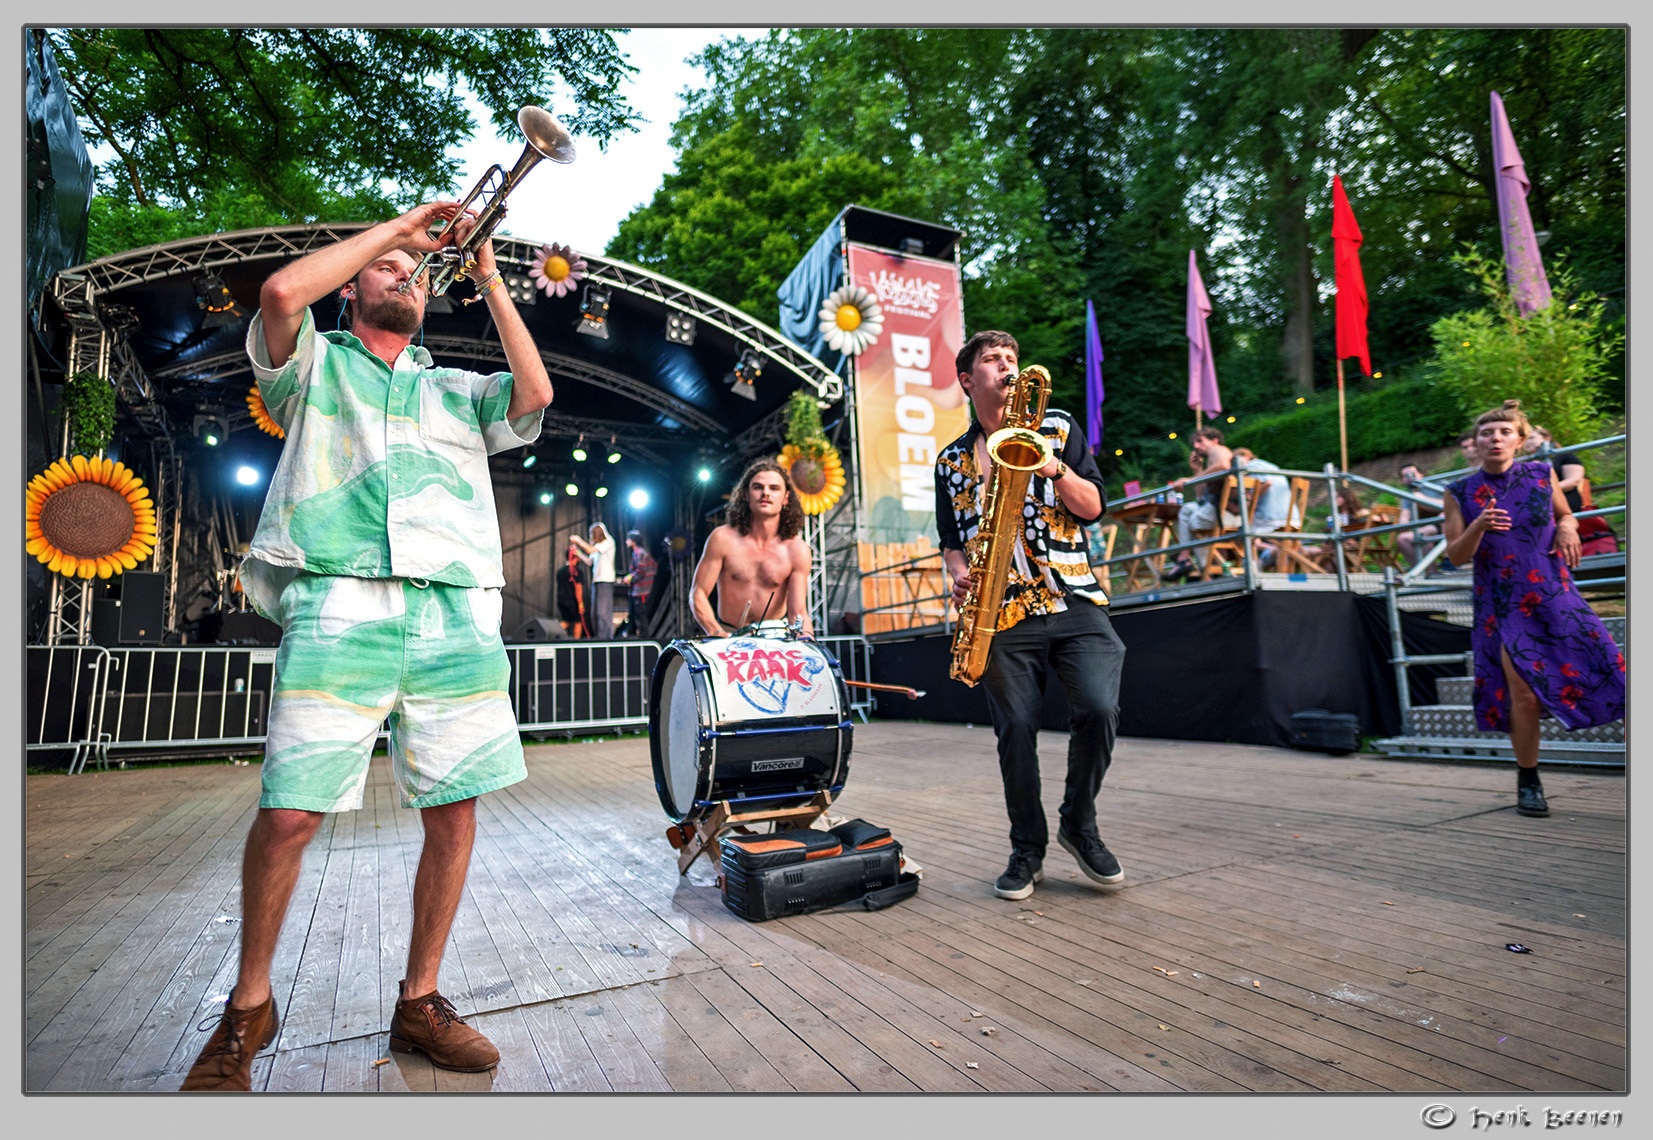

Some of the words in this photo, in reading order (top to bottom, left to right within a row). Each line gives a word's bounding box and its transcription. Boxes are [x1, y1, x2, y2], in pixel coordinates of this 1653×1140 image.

[890, 332, 936, 512] BLOEM
[726, 659, 812, 687] KAAK
[753, 761, 795, 771] Vancore
